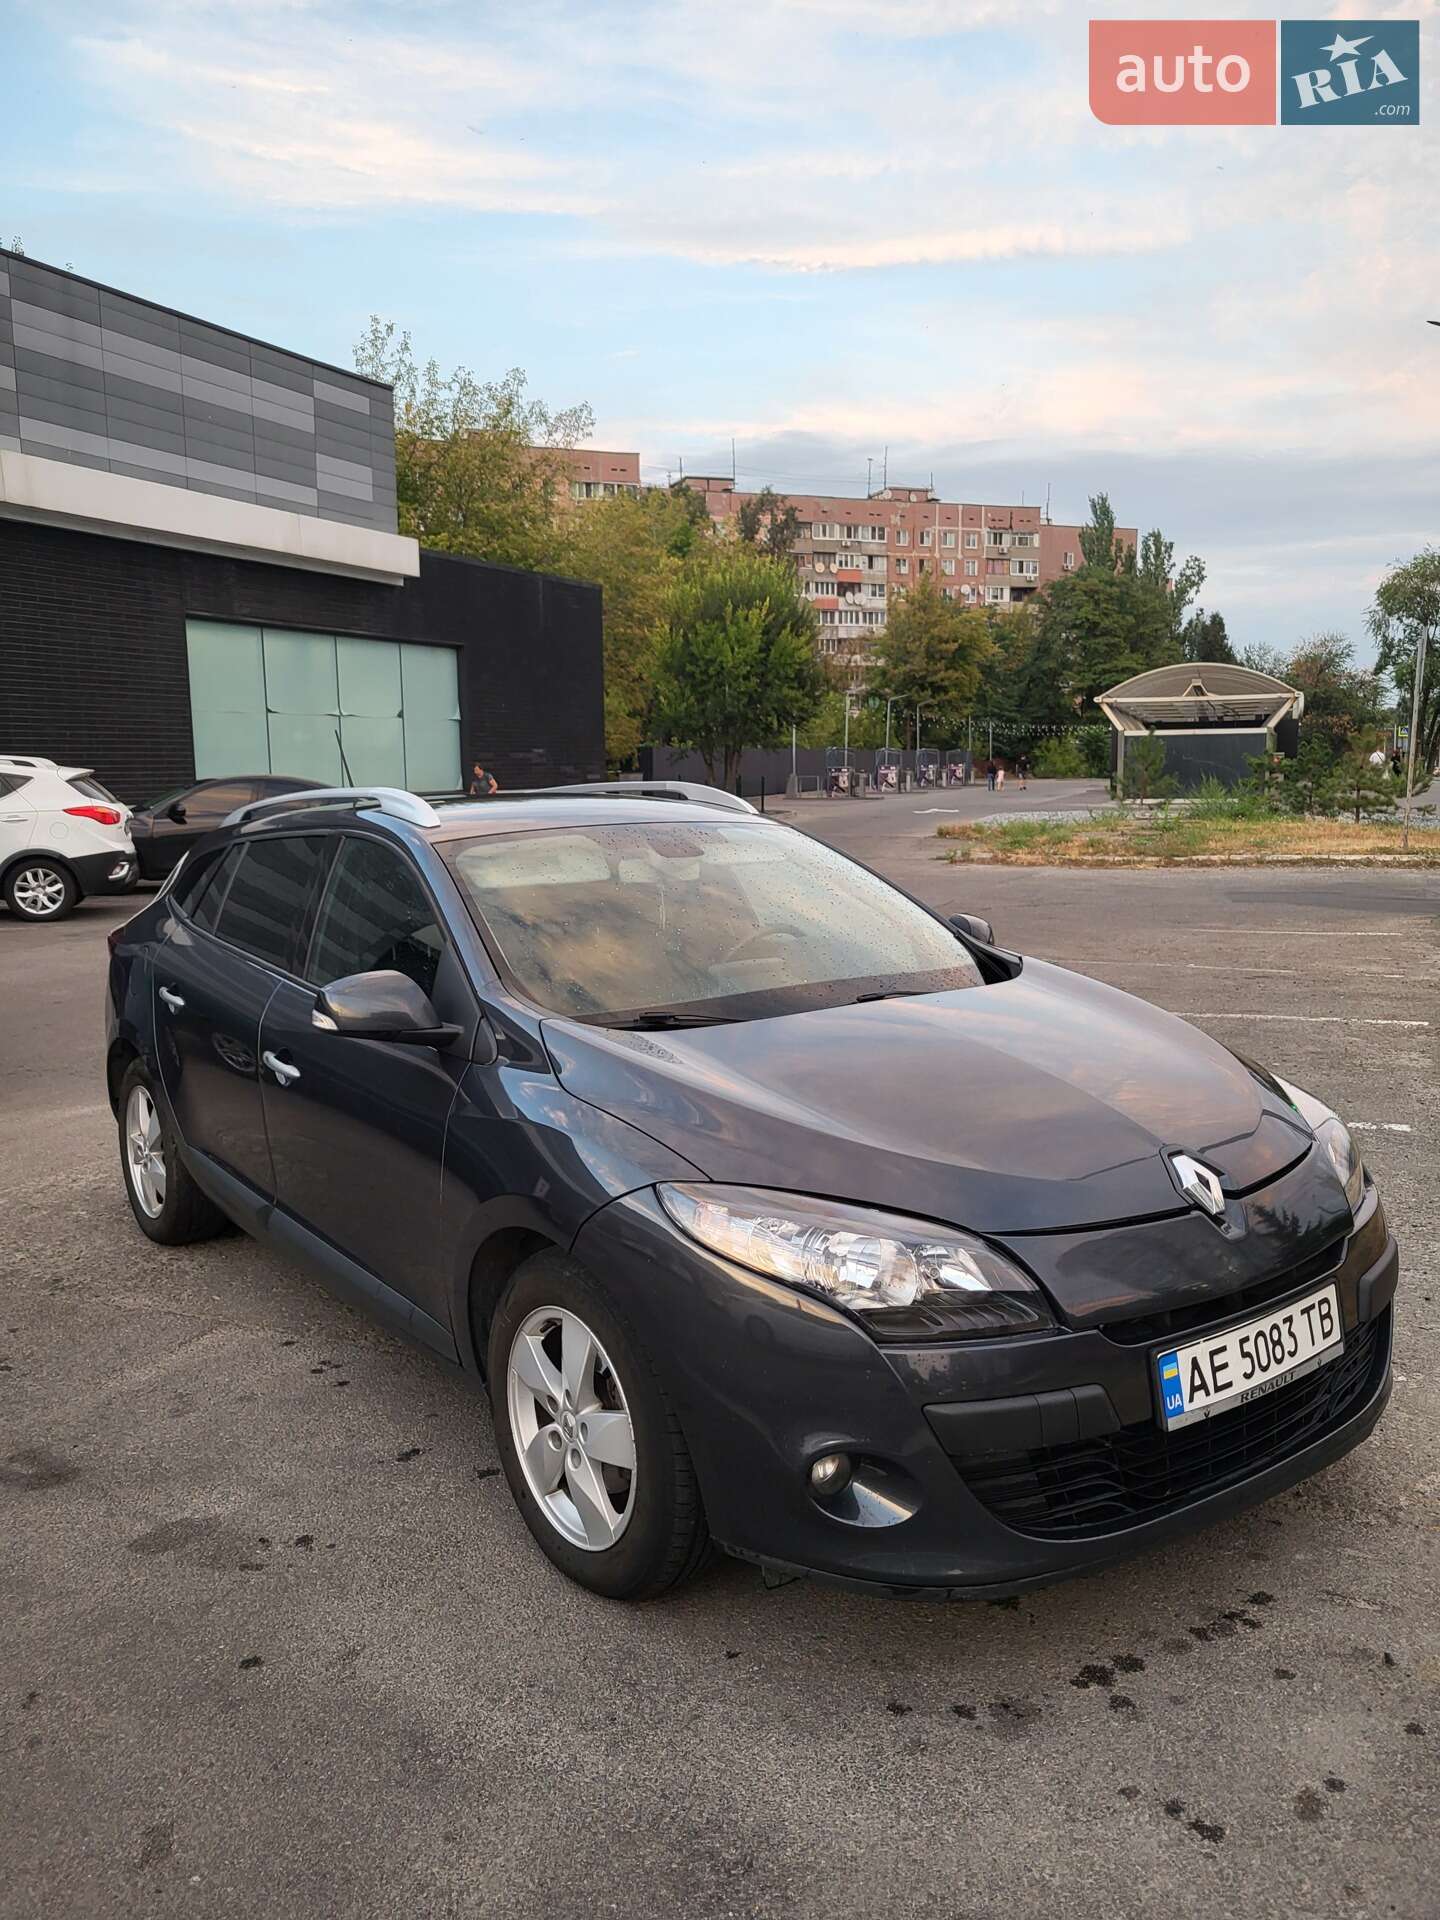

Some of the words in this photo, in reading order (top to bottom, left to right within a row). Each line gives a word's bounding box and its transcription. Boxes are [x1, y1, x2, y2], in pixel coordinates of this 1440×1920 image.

[1188, 1345, 1233, 1404] AE
[1238, 1315, 1298, 1380] 5083
[1300, 1297, 1335, 1347] TB
[1167, 1393, 1183, 1410] UA
[1240, 1370, 1297, 1403] RENAULT
